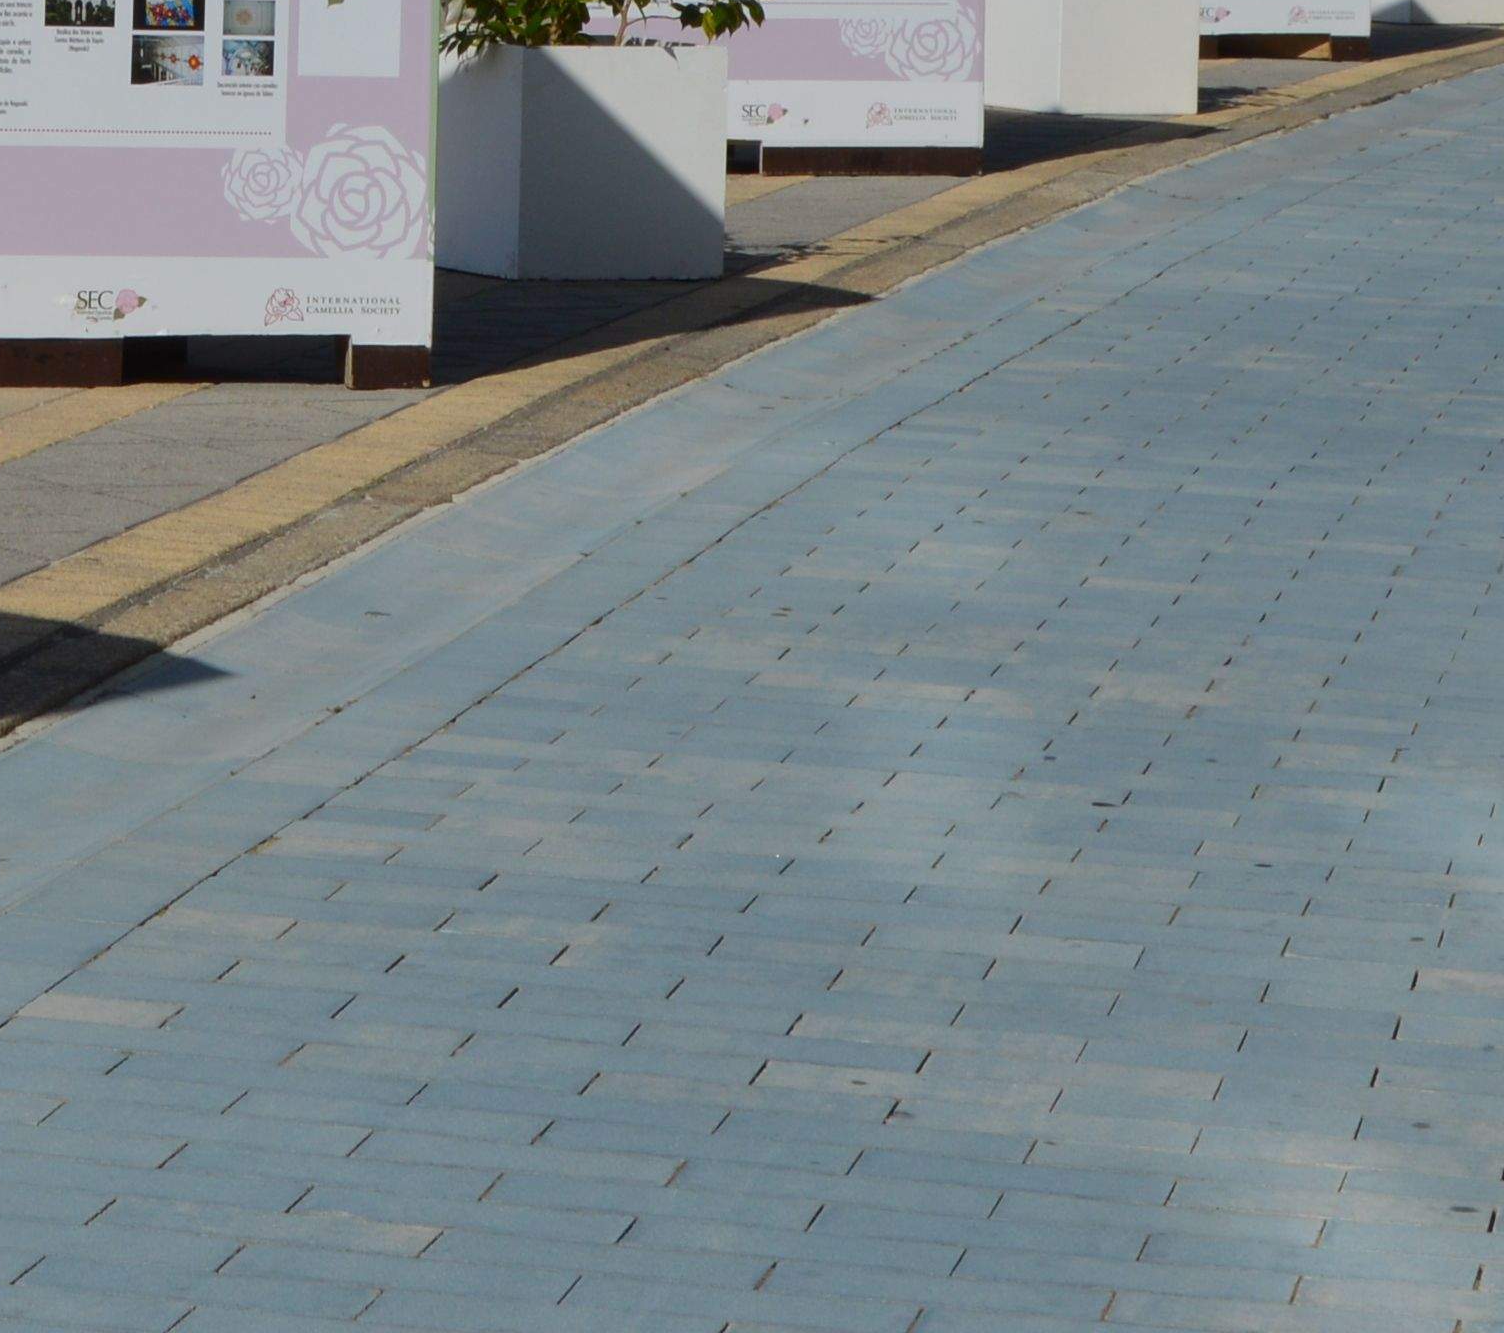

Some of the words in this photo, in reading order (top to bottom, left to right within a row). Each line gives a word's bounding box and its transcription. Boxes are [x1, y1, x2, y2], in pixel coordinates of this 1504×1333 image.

[76, 290, 114, 310] SEC
[306, 296, 401, 305] INTERNATIONAL
[306, 306, 355, 315] CAMELLIA
[360, 306, 401, 315] SOCIETY
